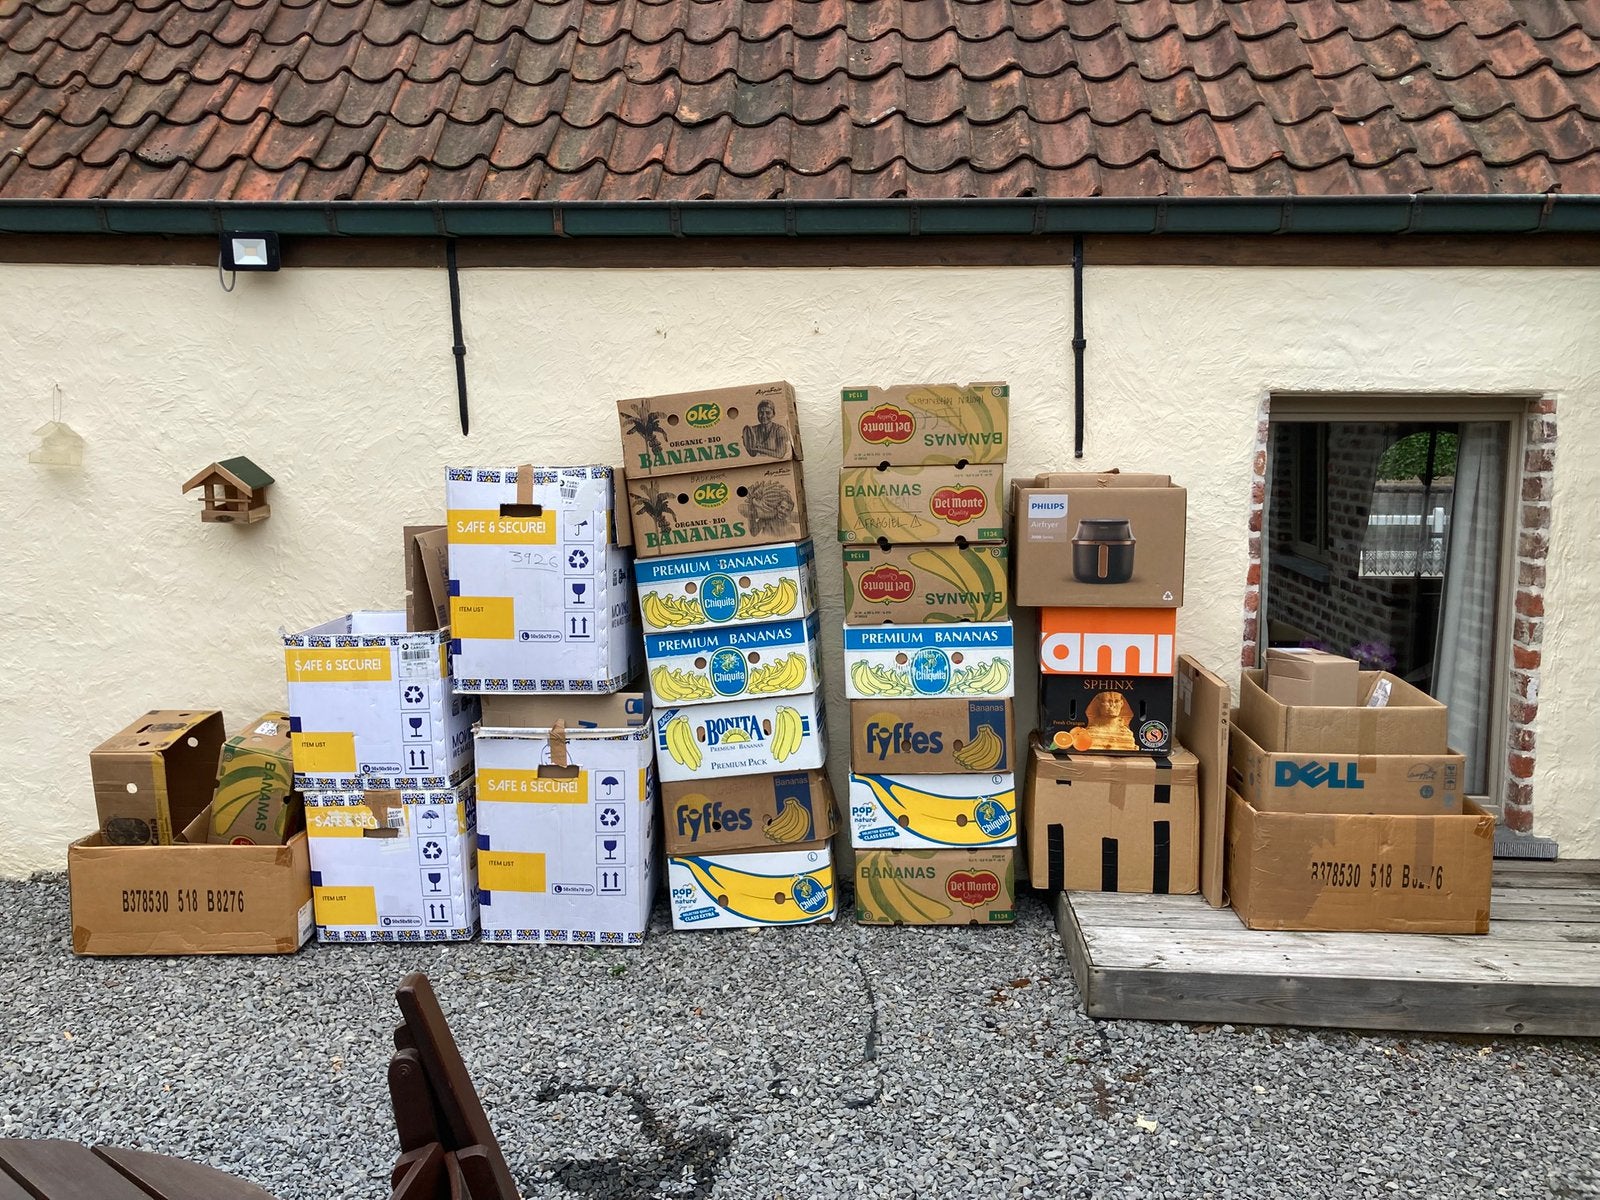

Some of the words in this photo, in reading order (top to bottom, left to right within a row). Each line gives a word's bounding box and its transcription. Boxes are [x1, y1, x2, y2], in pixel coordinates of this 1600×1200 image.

[687, 403, 717, 422] oké
[863, 422, 894, 432] Monte
[894, 422, 912, 432] Del
[670, 439, 702, 448] ORGANIC
[925, 432, 1002, 446] BANANAS
[638, 442, 741, 468] BANANAS
[695, 484, 724, 500] oké
[846, 484, 921, 497] BANANAS
[935, 498, 950, 508] Del
[952, 498, 983, 508] Monte
[457, 521, 485, 533] SAFE
[489, 522, 494, 533] &
[499, 521, 546, 533] SECURE!
[675, 519, 708, 528] ORGANIC
[1031, 521, 1059, 529] Airfryer
[645, 522, 746, 548] BANANAS
[509, 550, 558, 568] 3926
[653, 560, 710, 576] PREMIUM
[720, 553, 779, 570] BANANAS
[864, 582, 893, 591] Monte
[894, 582, 910, 591] Del
[705, 597, 735, 609] Chiquita
[926, 592, 1002, 605] BANANAS
[659, 635, 719, 651] PREMIUM
[729, 628, 792, 644] BANANAS
[862, 632, 923, 644] PREMIUM
[935, 631, 998, 642] BANANAS
[295, 660, 322, 671] SAFE
[326, 660, 332, 670] &
[336, 659, 381, 670] SECURE!
[714, 671, 745, 683] Chiquita
[916, 668, 946, 682] Chiquita
[1083, 680, 1134, 690] SPHINX
[970, 704, 1004, 712] Bananas
[659, 711, 673, 725] BAGS
[705, 715, 764, 746] BONITA
[867, 722, 943, 760] fyffes
[711, 760, 746, 770] PREMIUM
[748, 758, 768, 766] PACK
[1275, 761, 1364, 788] DELL
[488, 779, 517, 792] SAFE
[521, 780, 527, 792] &
[530, 780, 578, 792] SECURE!
[775, 777, 808, 786] Bananas
[255, 762, 275, 832] BANANAS
[852, 807, 872, 816] pop
[315, 815, 343, 827] SAFE
[676, 802, 752, 842] fyffes
[981, 813, 1010, 834] Chiquita
[861, 867, 935, 878] BANANAS
[1370, 863, 1392, 888] 518
[673, 888, 692, 898] pop
[951, 882, 965, 890] Del
[967, 882, 997, 891] Monte
[122, 890, 169, 912] B378530
[178, 890, 198, 912] 518
[207, 890, 244, 912] B8276
[799, 890, 827, 911] Chiquita
